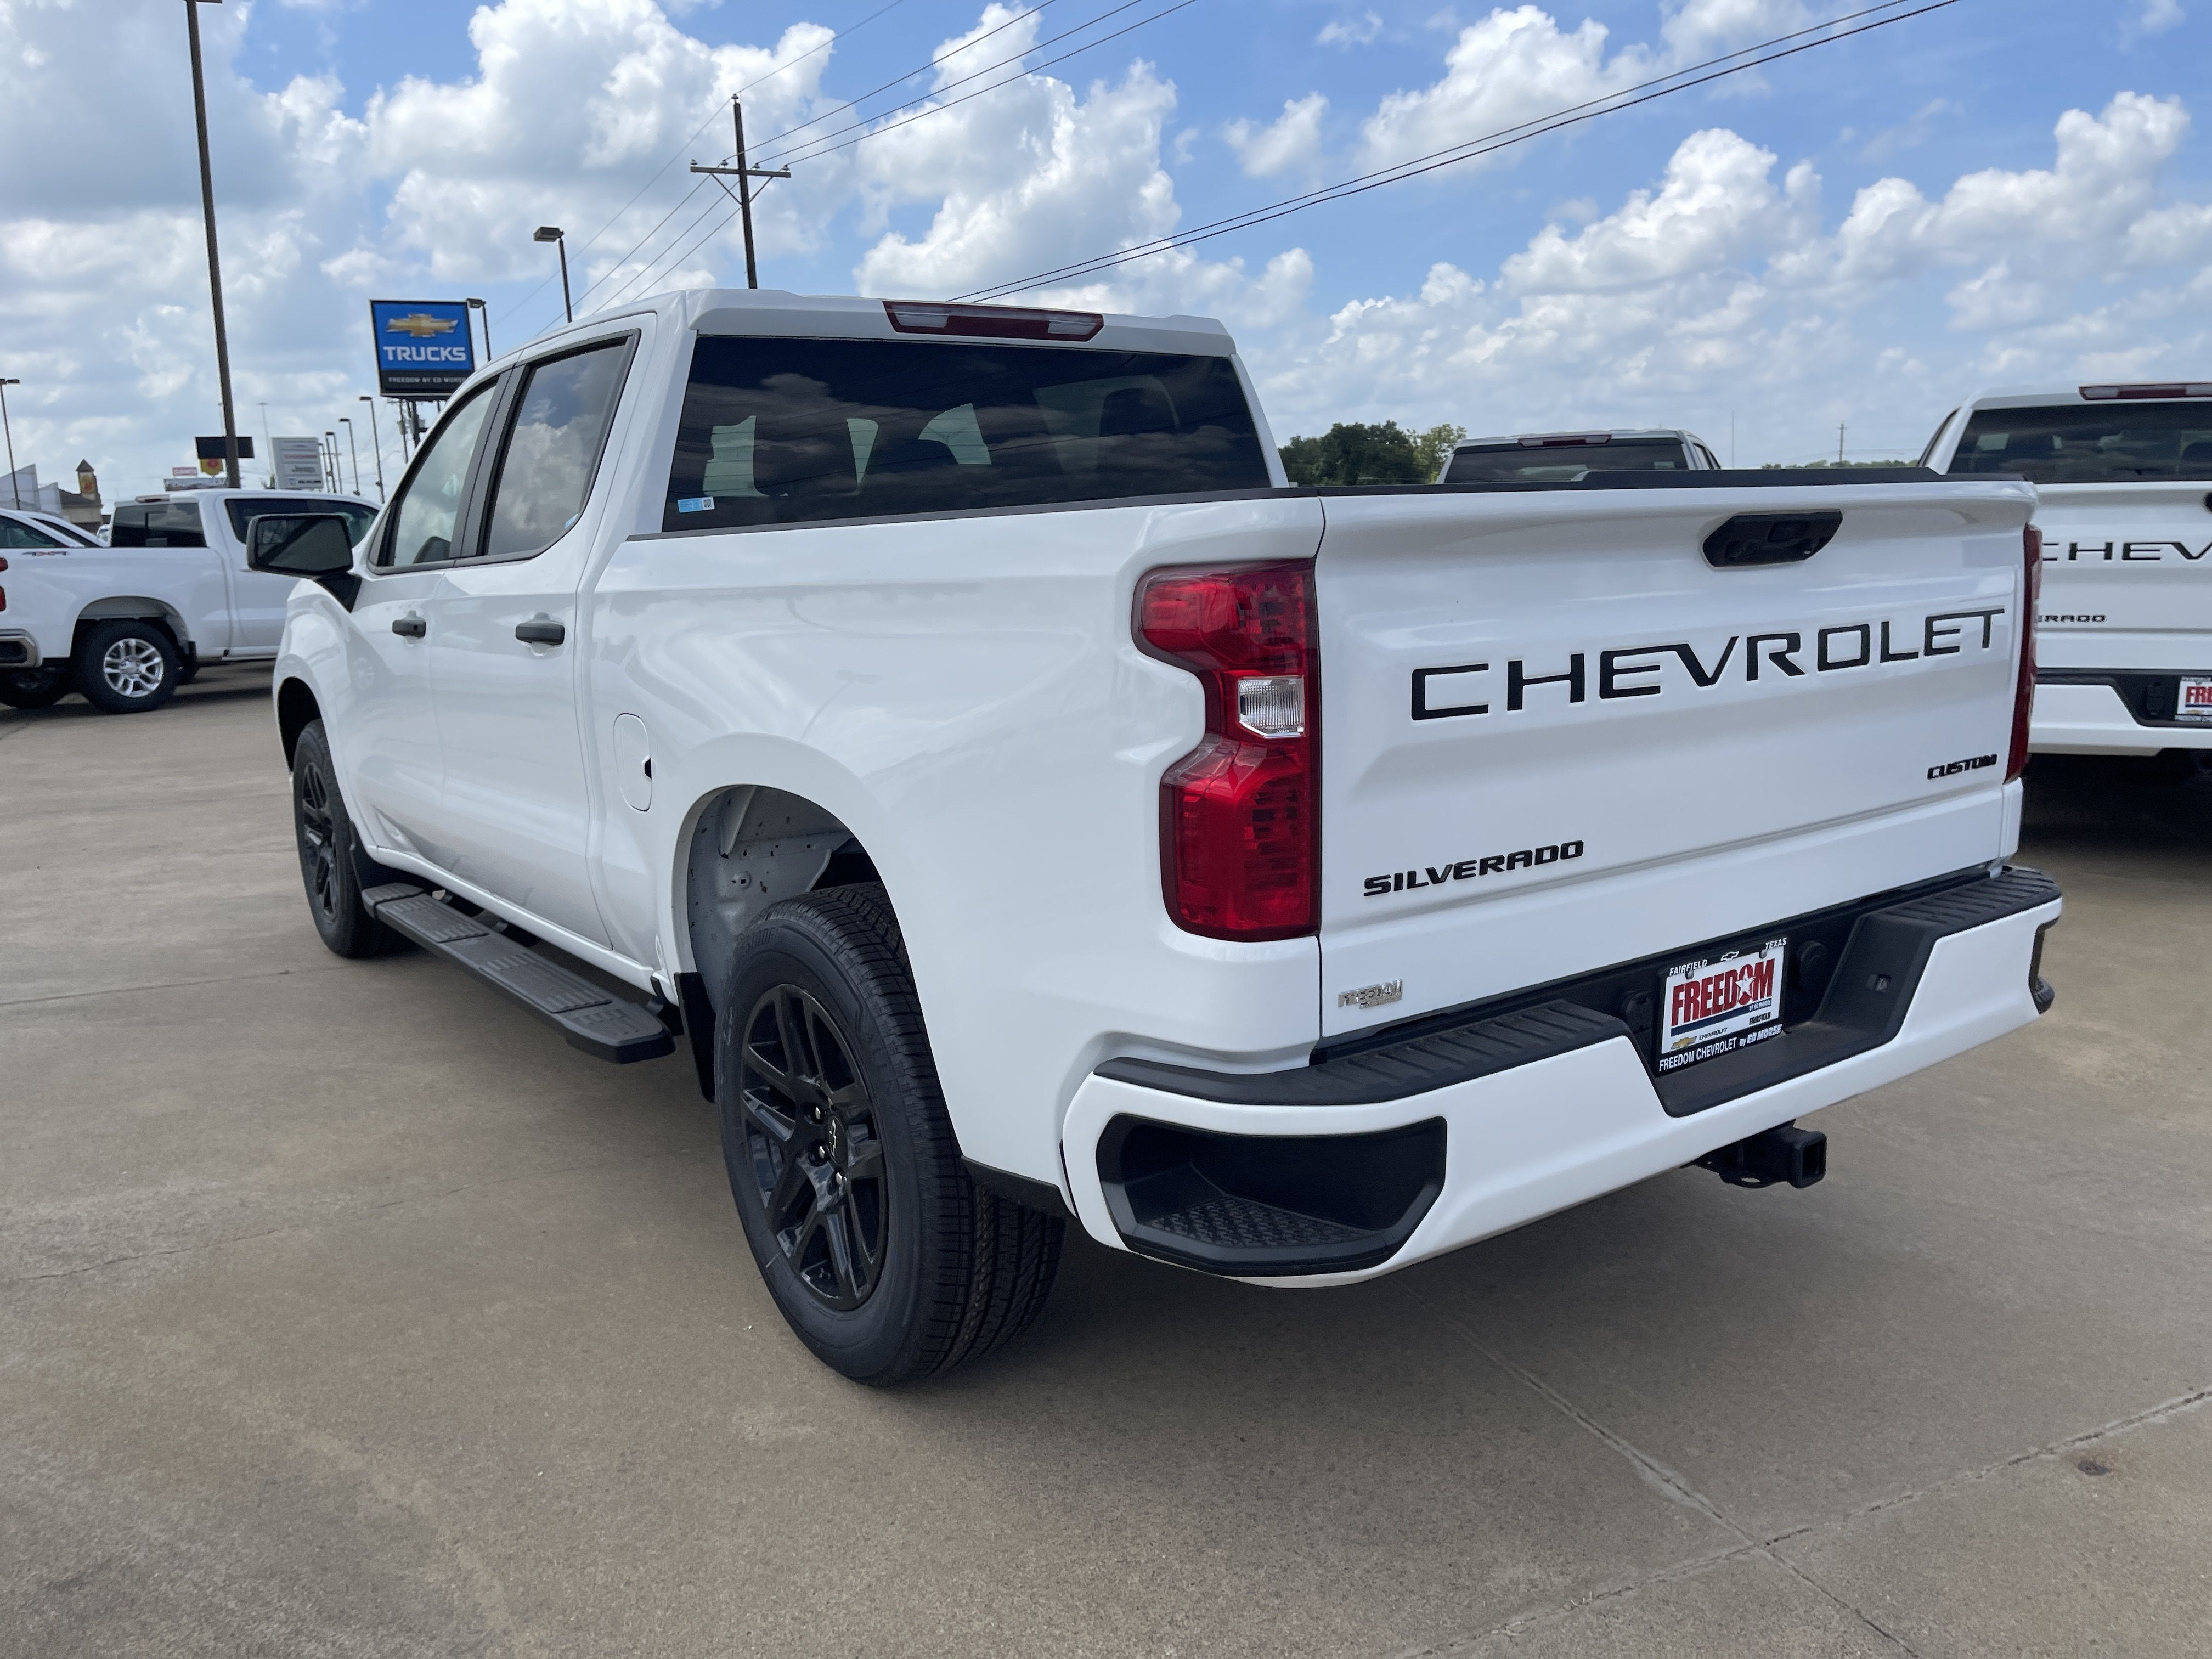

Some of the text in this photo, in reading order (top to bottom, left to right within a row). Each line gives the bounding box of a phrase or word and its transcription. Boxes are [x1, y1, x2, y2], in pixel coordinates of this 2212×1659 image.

[383, 346, 466, 361] TRUCKS
[1411, 608, 2005, 721] CHEVROLET
[1927, 753, 1997, 780] CUSTOM
[1364, 840, 1584, 897] SILVERADO
[1669, 937, 1787, 976] FAIRFIELD TEXAS
[1671, 958, 1775, 1027] FREEDOM
[1659, 1052, 1695, 1071] FREEDOM
[1696, 1036, 1737, 1060] CHEVROLET
[1746, 1032, 1757, 1045] ED
[1756, 1024, 1783, 1041] MORSE
[1699, 1027, 1728, 1040] CHEVROLET
